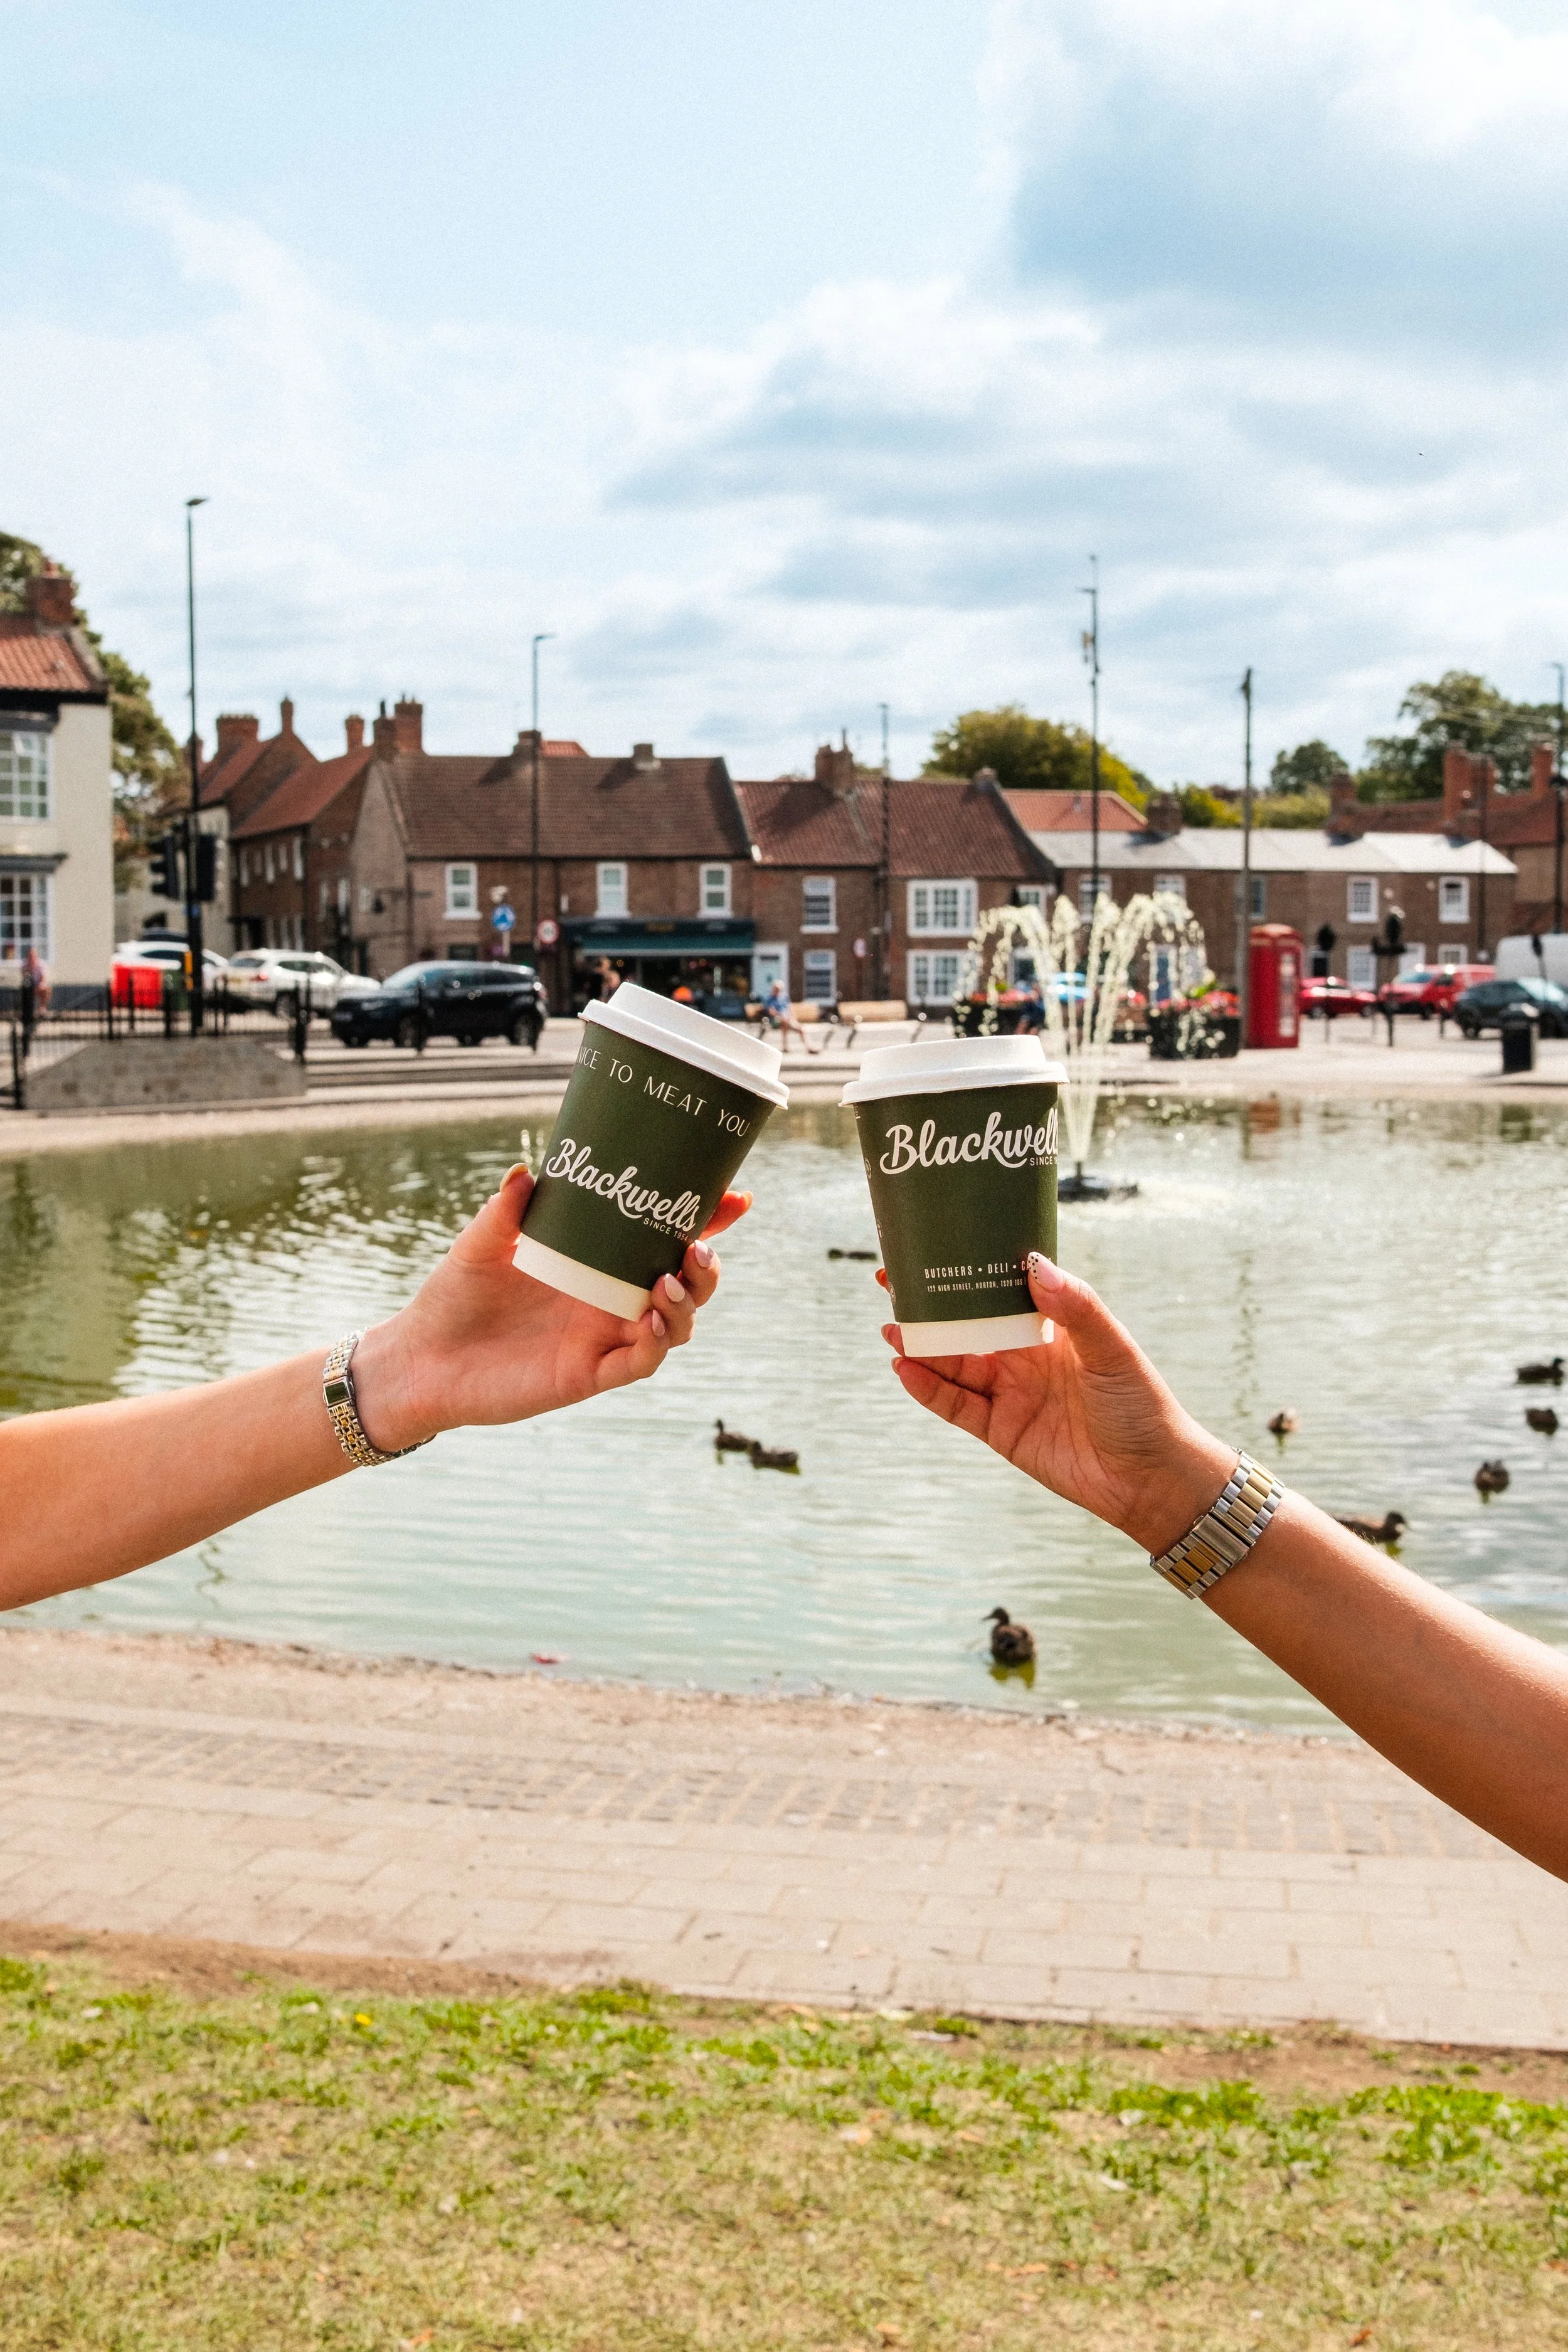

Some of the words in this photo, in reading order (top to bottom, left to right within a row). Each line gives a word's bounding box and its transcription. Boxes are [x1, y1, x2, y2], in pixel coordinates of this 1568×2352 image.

[576, 1046, 601, 1069] NICE
[610, 1058, 633, 1083] TO
[644, 1076, 707, 1116] MEAT
[718, 1108, 750, 1136] YOU
[1030, 1156, 1053, 1166] SINCE
[546, 1138, 701, 1232] Blackwells
[644, 1217, 671, 1234] SINCE
[674, 1231, 689, 1241] 1954
[924, 1265, 973, 1279] BUTCHERS
[988, 1262, 1009, 1274] DELI
[953, 1283, 973, 1291] STREET,
